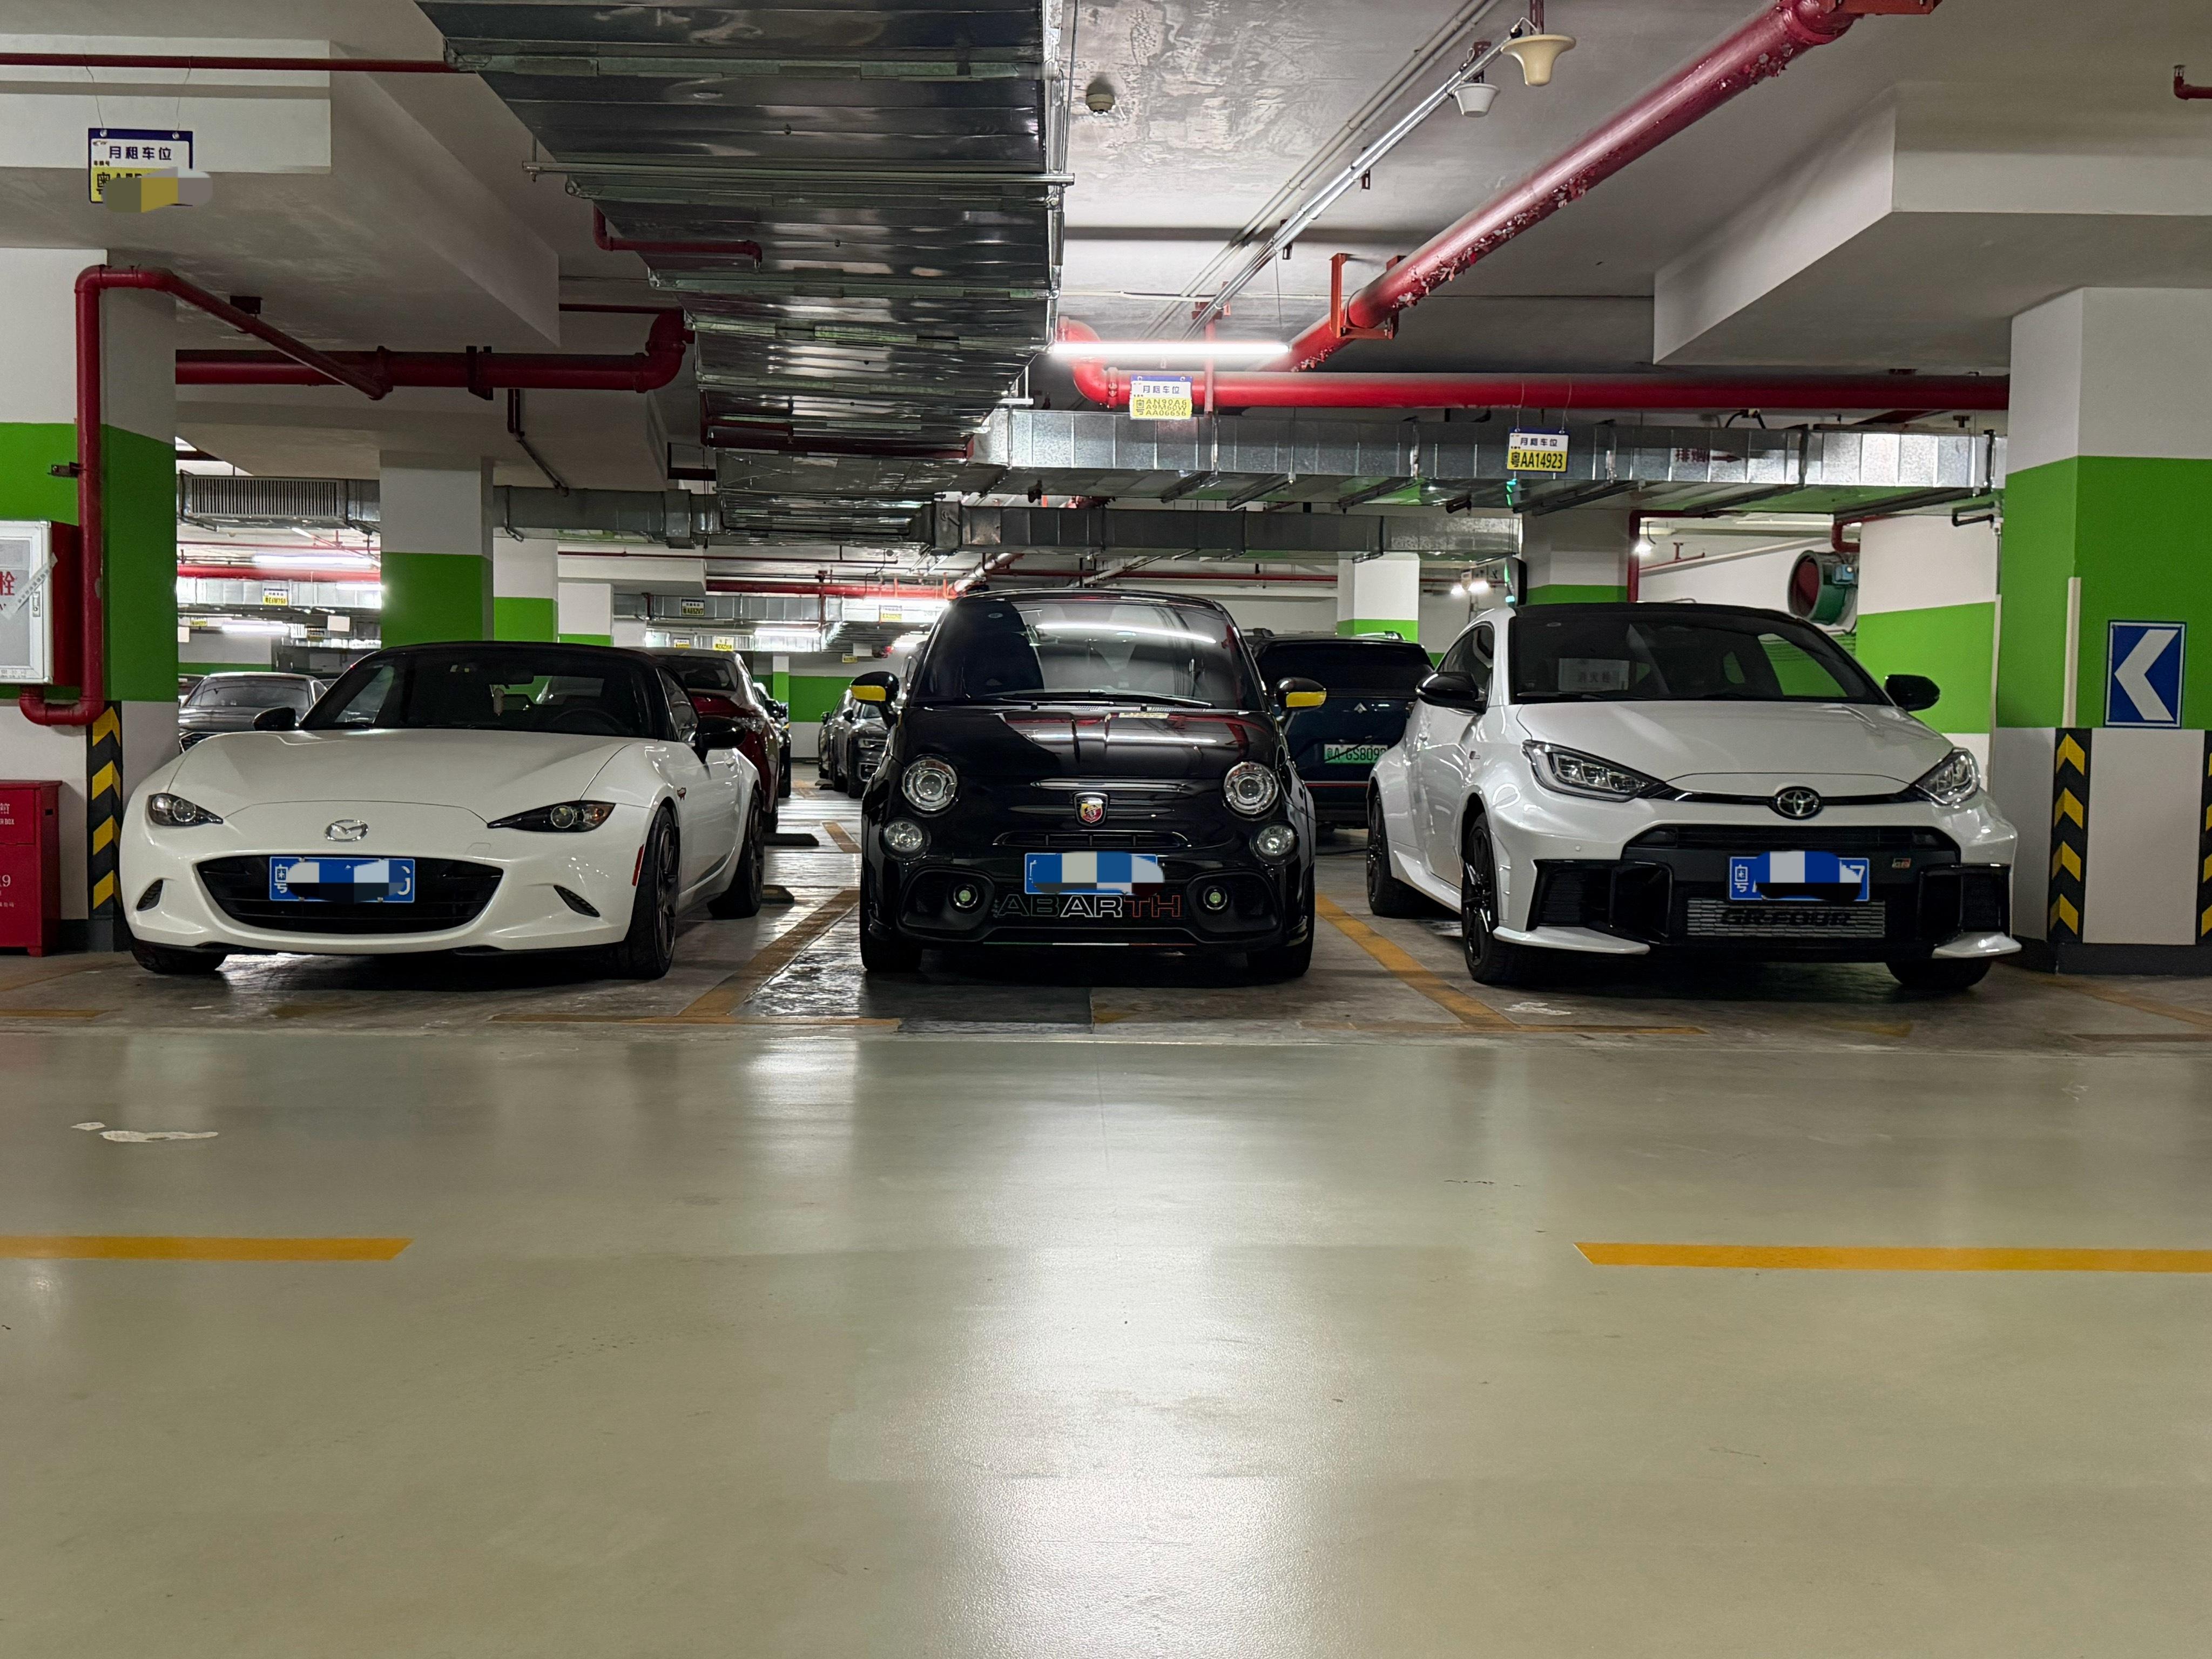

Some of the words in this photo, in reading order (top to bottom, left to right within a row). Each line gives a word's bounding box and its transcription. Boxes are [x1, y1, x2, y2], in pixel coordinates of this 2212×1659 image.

[109, 146, 172, 160] 月租车位
[1143, 385, 1179, 394] 月租车位
[1520, 437, 1557, 447] 月租车位
[997, 894, 1182, 918] ABARTH
